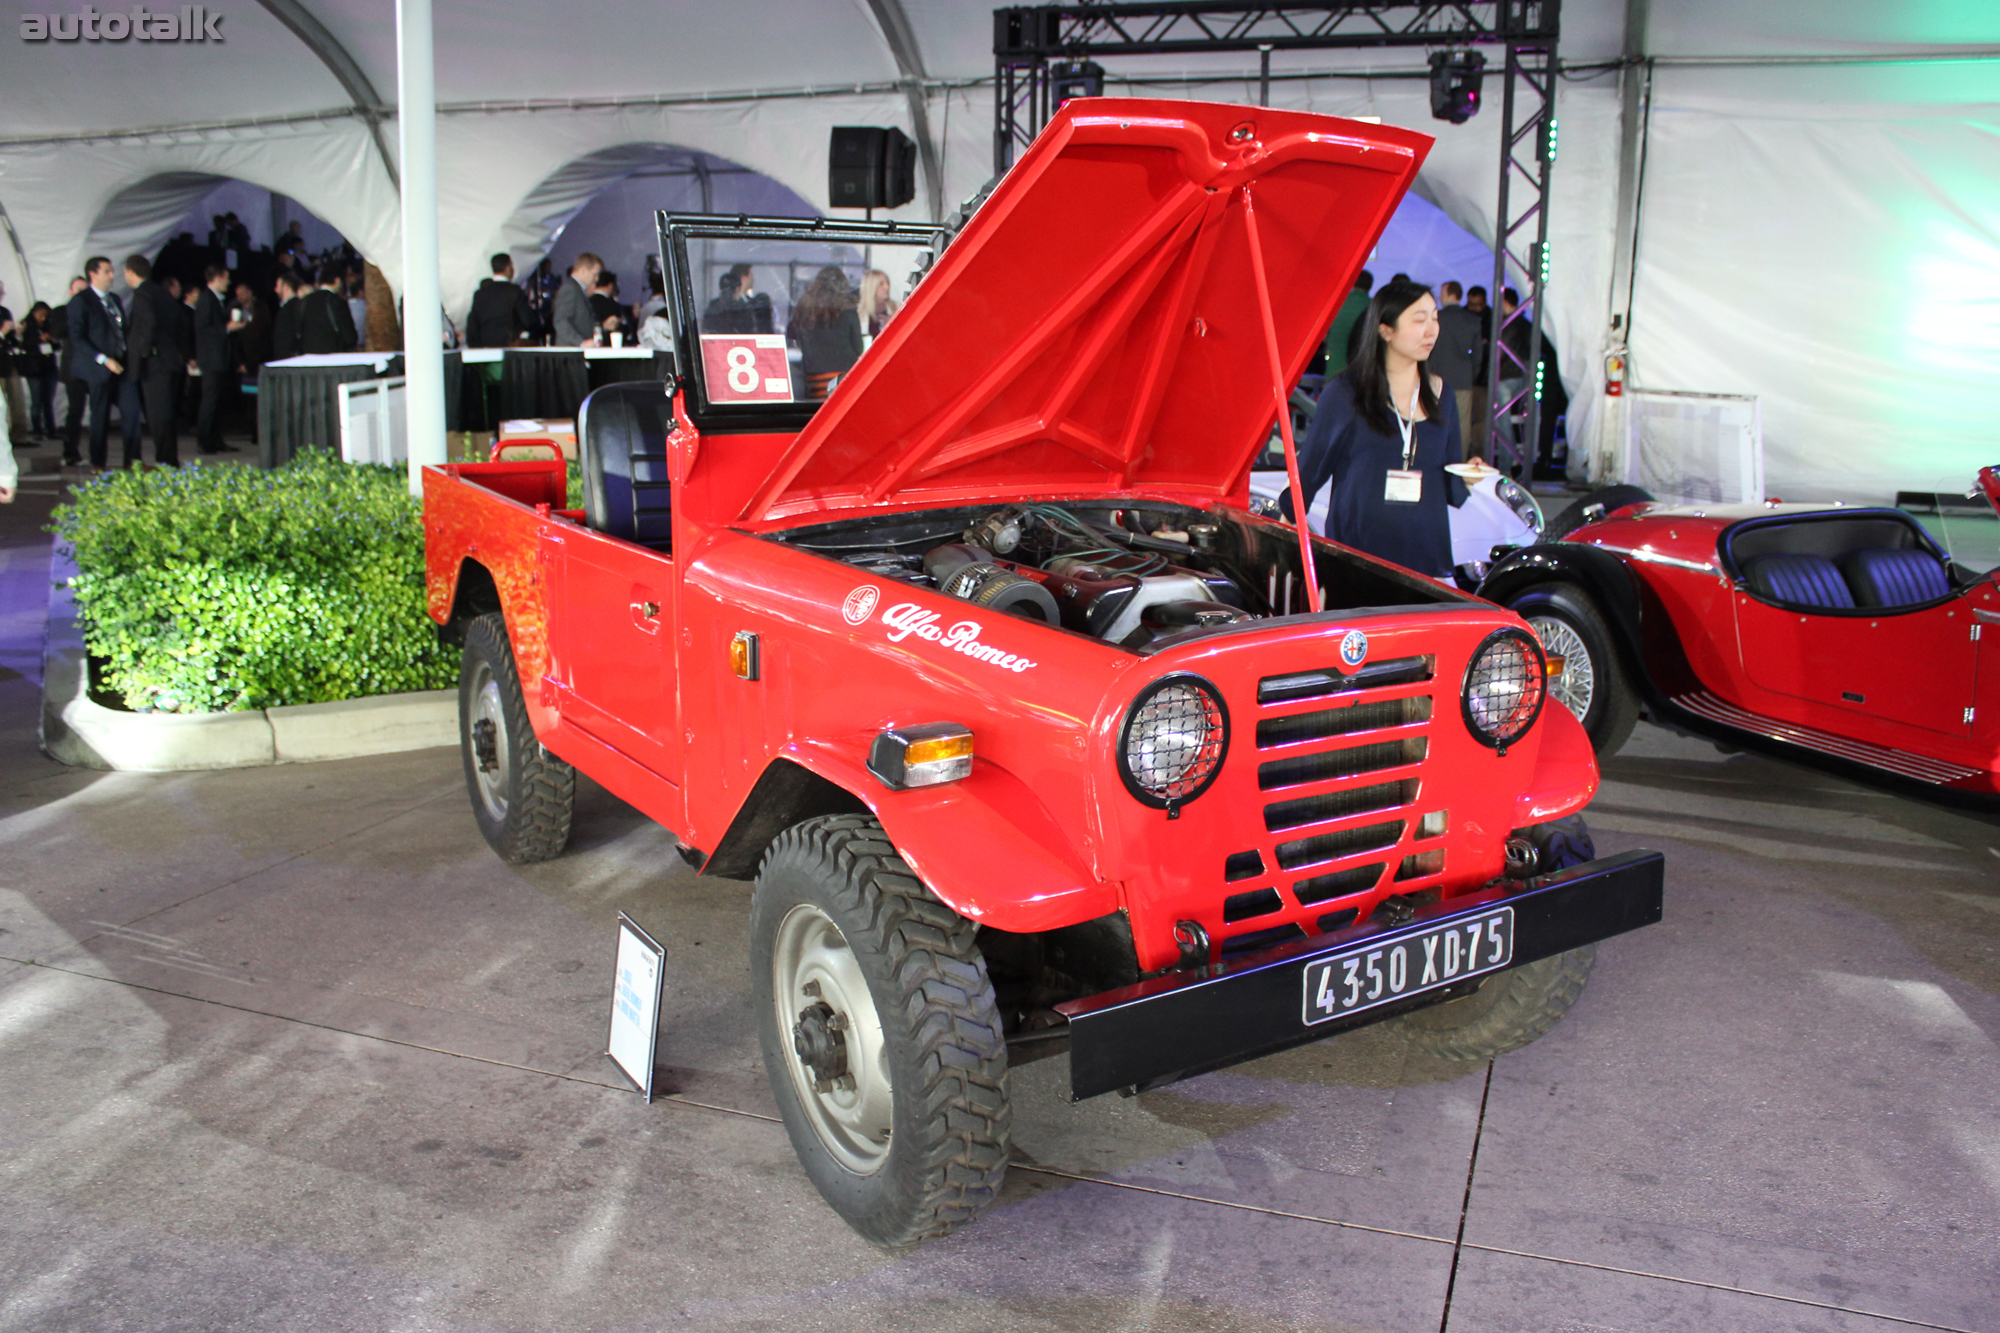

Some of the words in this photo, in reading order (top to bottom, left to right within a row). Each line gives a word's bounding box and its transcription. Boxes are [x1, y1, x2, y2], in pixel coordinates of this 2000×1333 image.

[726, 346, 760, 393] 8
[881, 603, 942, 642] Alfa
[940, 621, 1037, 672] Romeo
[1316, 945, 1407, 1014] 4350
